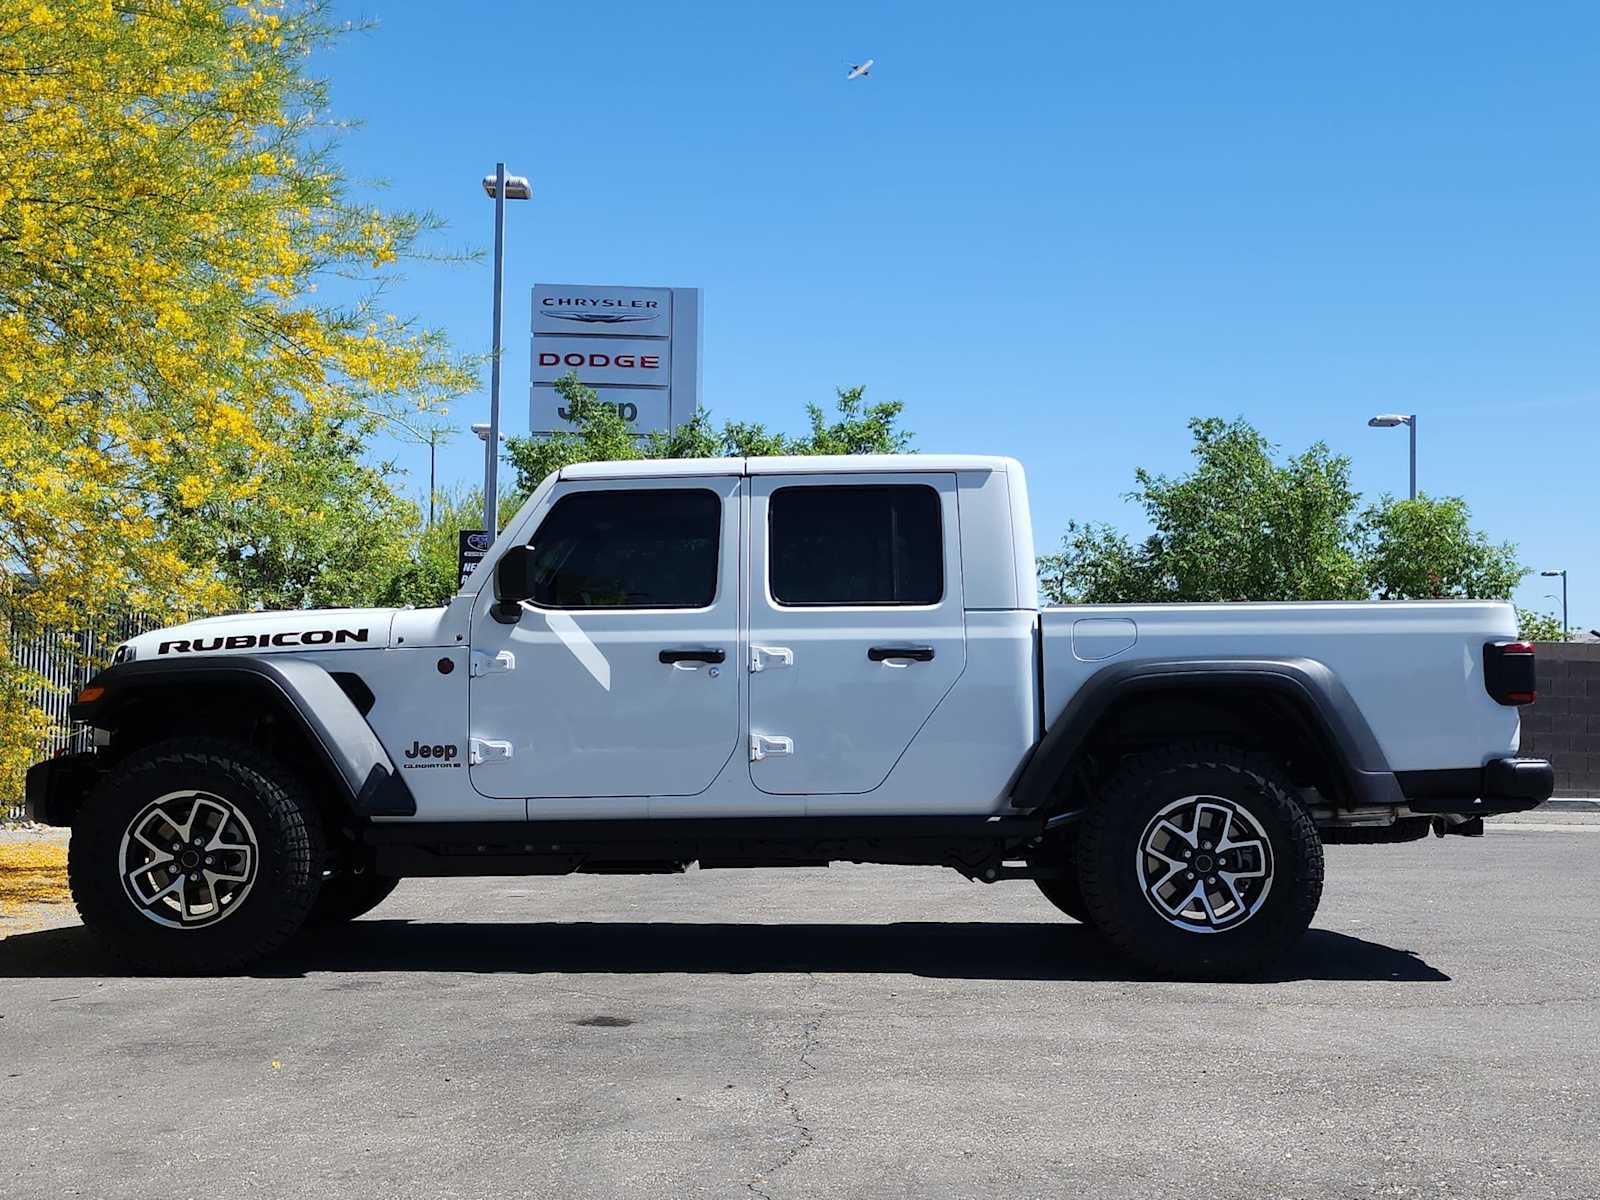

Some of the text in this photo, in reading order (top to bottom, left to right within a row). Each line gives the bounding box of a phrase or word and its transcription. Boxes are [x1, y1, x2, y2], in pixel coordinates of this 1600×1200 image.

[542, 298, 658, 309] CHRYSLER
[539, 353, 660, 369] DODGE
[557, 398, 638, 423] Jp
[157, 628, 369, 655] RUBICON
[404, 741, 458, 762] Jeep
